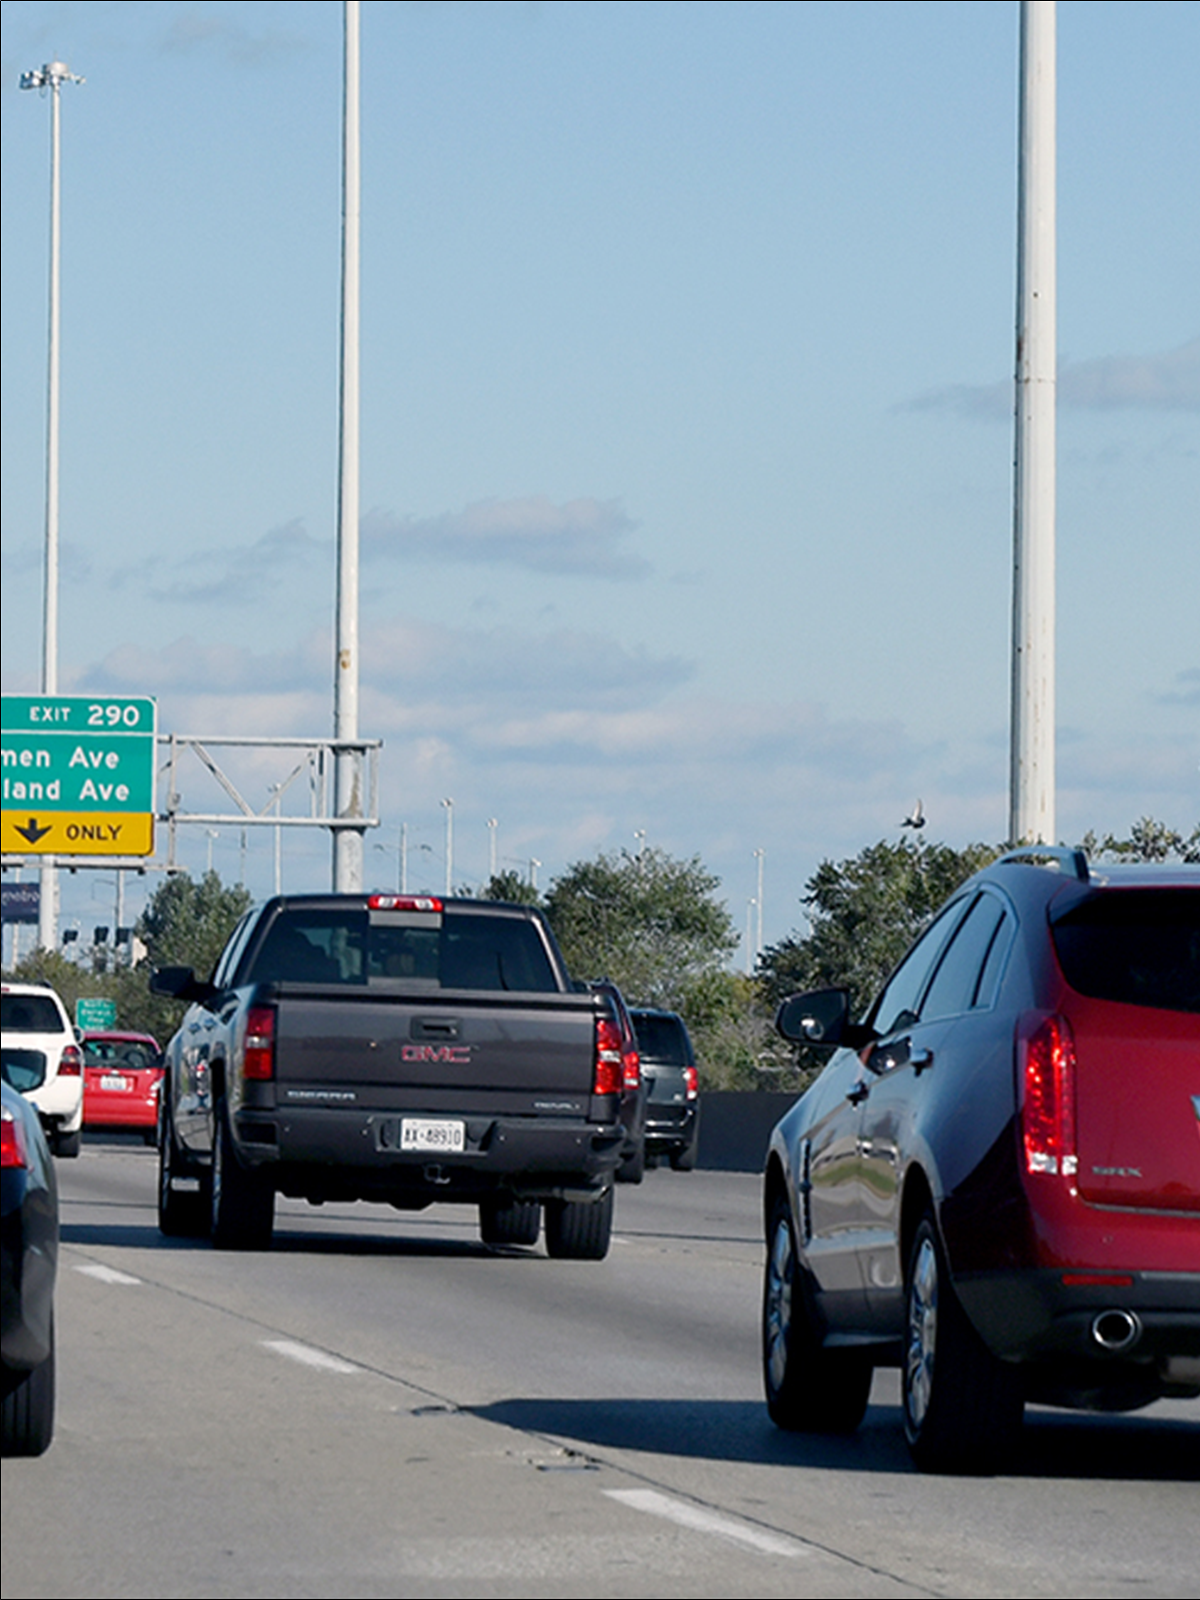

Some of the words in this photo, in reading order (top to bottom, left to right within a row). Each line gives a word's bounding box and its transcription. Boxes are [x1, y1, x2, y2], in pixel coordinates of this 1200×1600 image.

[29, 706, 71, 721] EXIT
[87, 704, 140, 727] 290
[68, 746, 120, 769] Ave
[3, 778, 61, 800] land
[79, 778, 130, 801] Ave
[66, 823, 122, 841] ONLY
[401, 1045, 471, 1063] GMC
